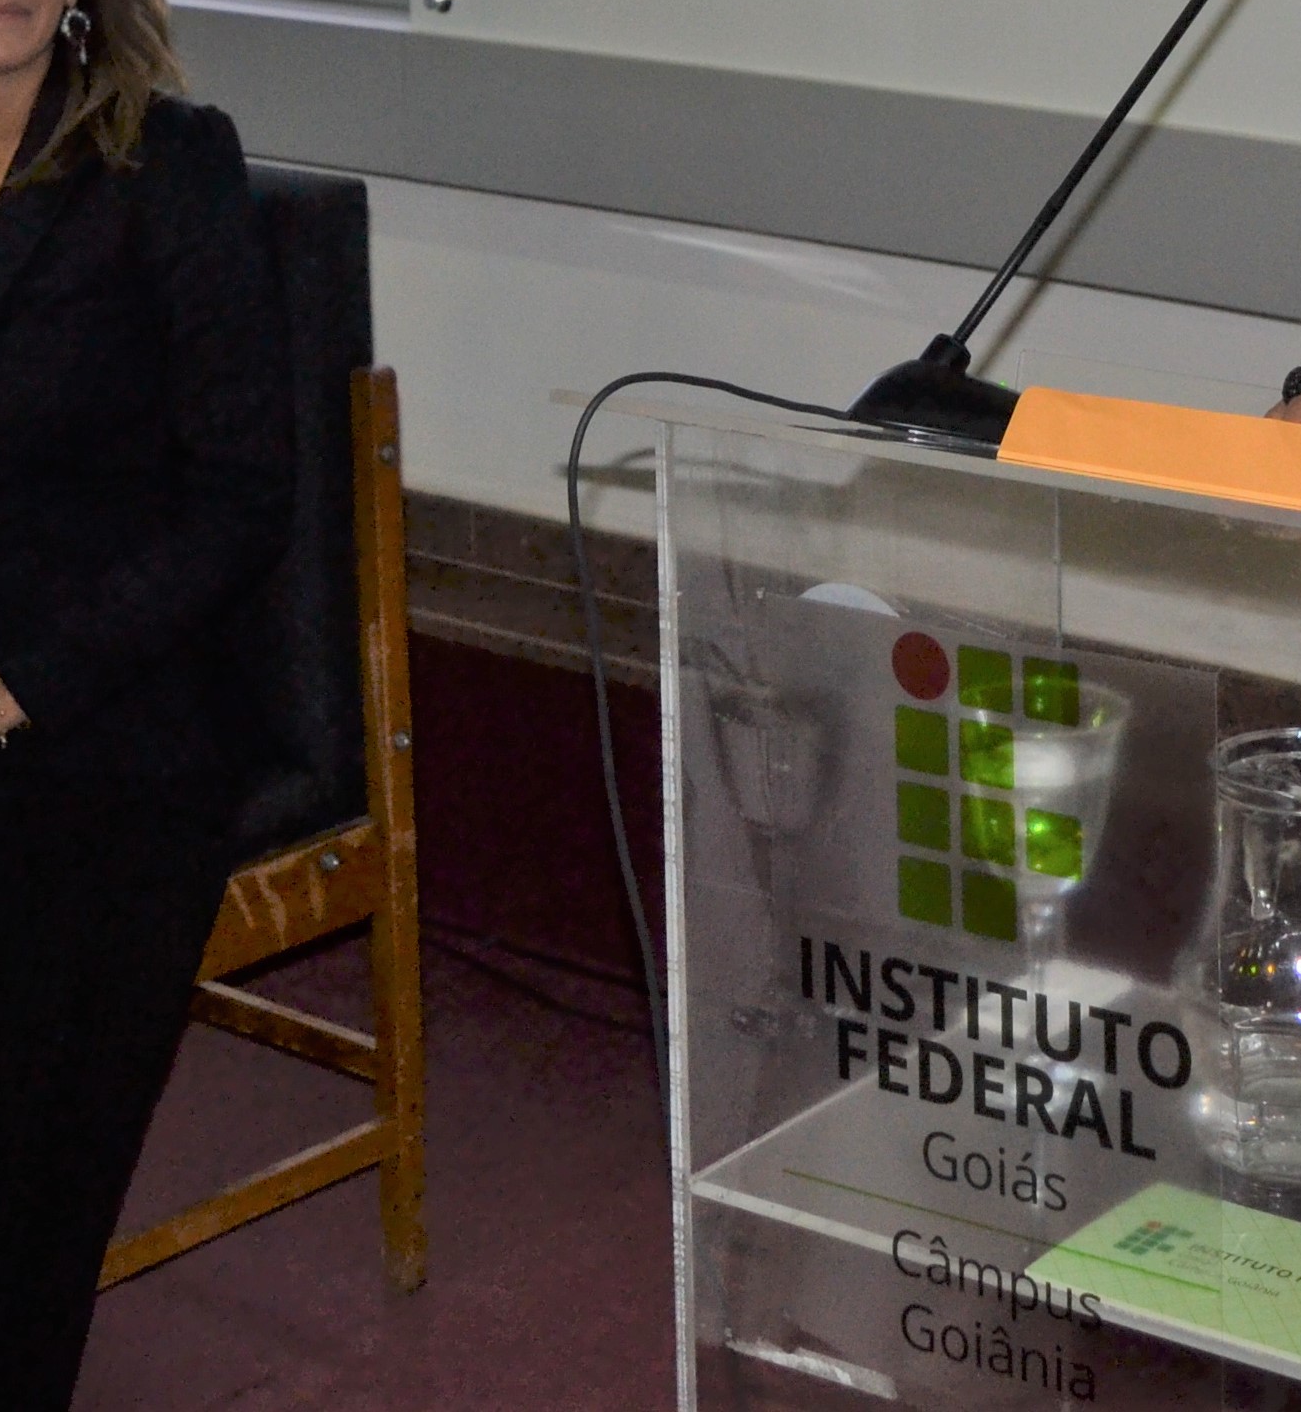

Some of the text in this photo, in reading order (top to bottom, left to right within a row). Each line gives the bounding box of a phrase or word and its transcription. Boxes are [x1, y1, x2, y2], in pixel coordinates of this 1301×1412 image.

[799, 935, 1193, 1090] INSTITUTO
[836, 1017, 1157, 1162] FEDERAL
[922, 1131, 1068, 1213] Goiás
[892, 1229, 1102, 1332] Câmpus
[901, 1303, 1096, 1402] Goiânia
